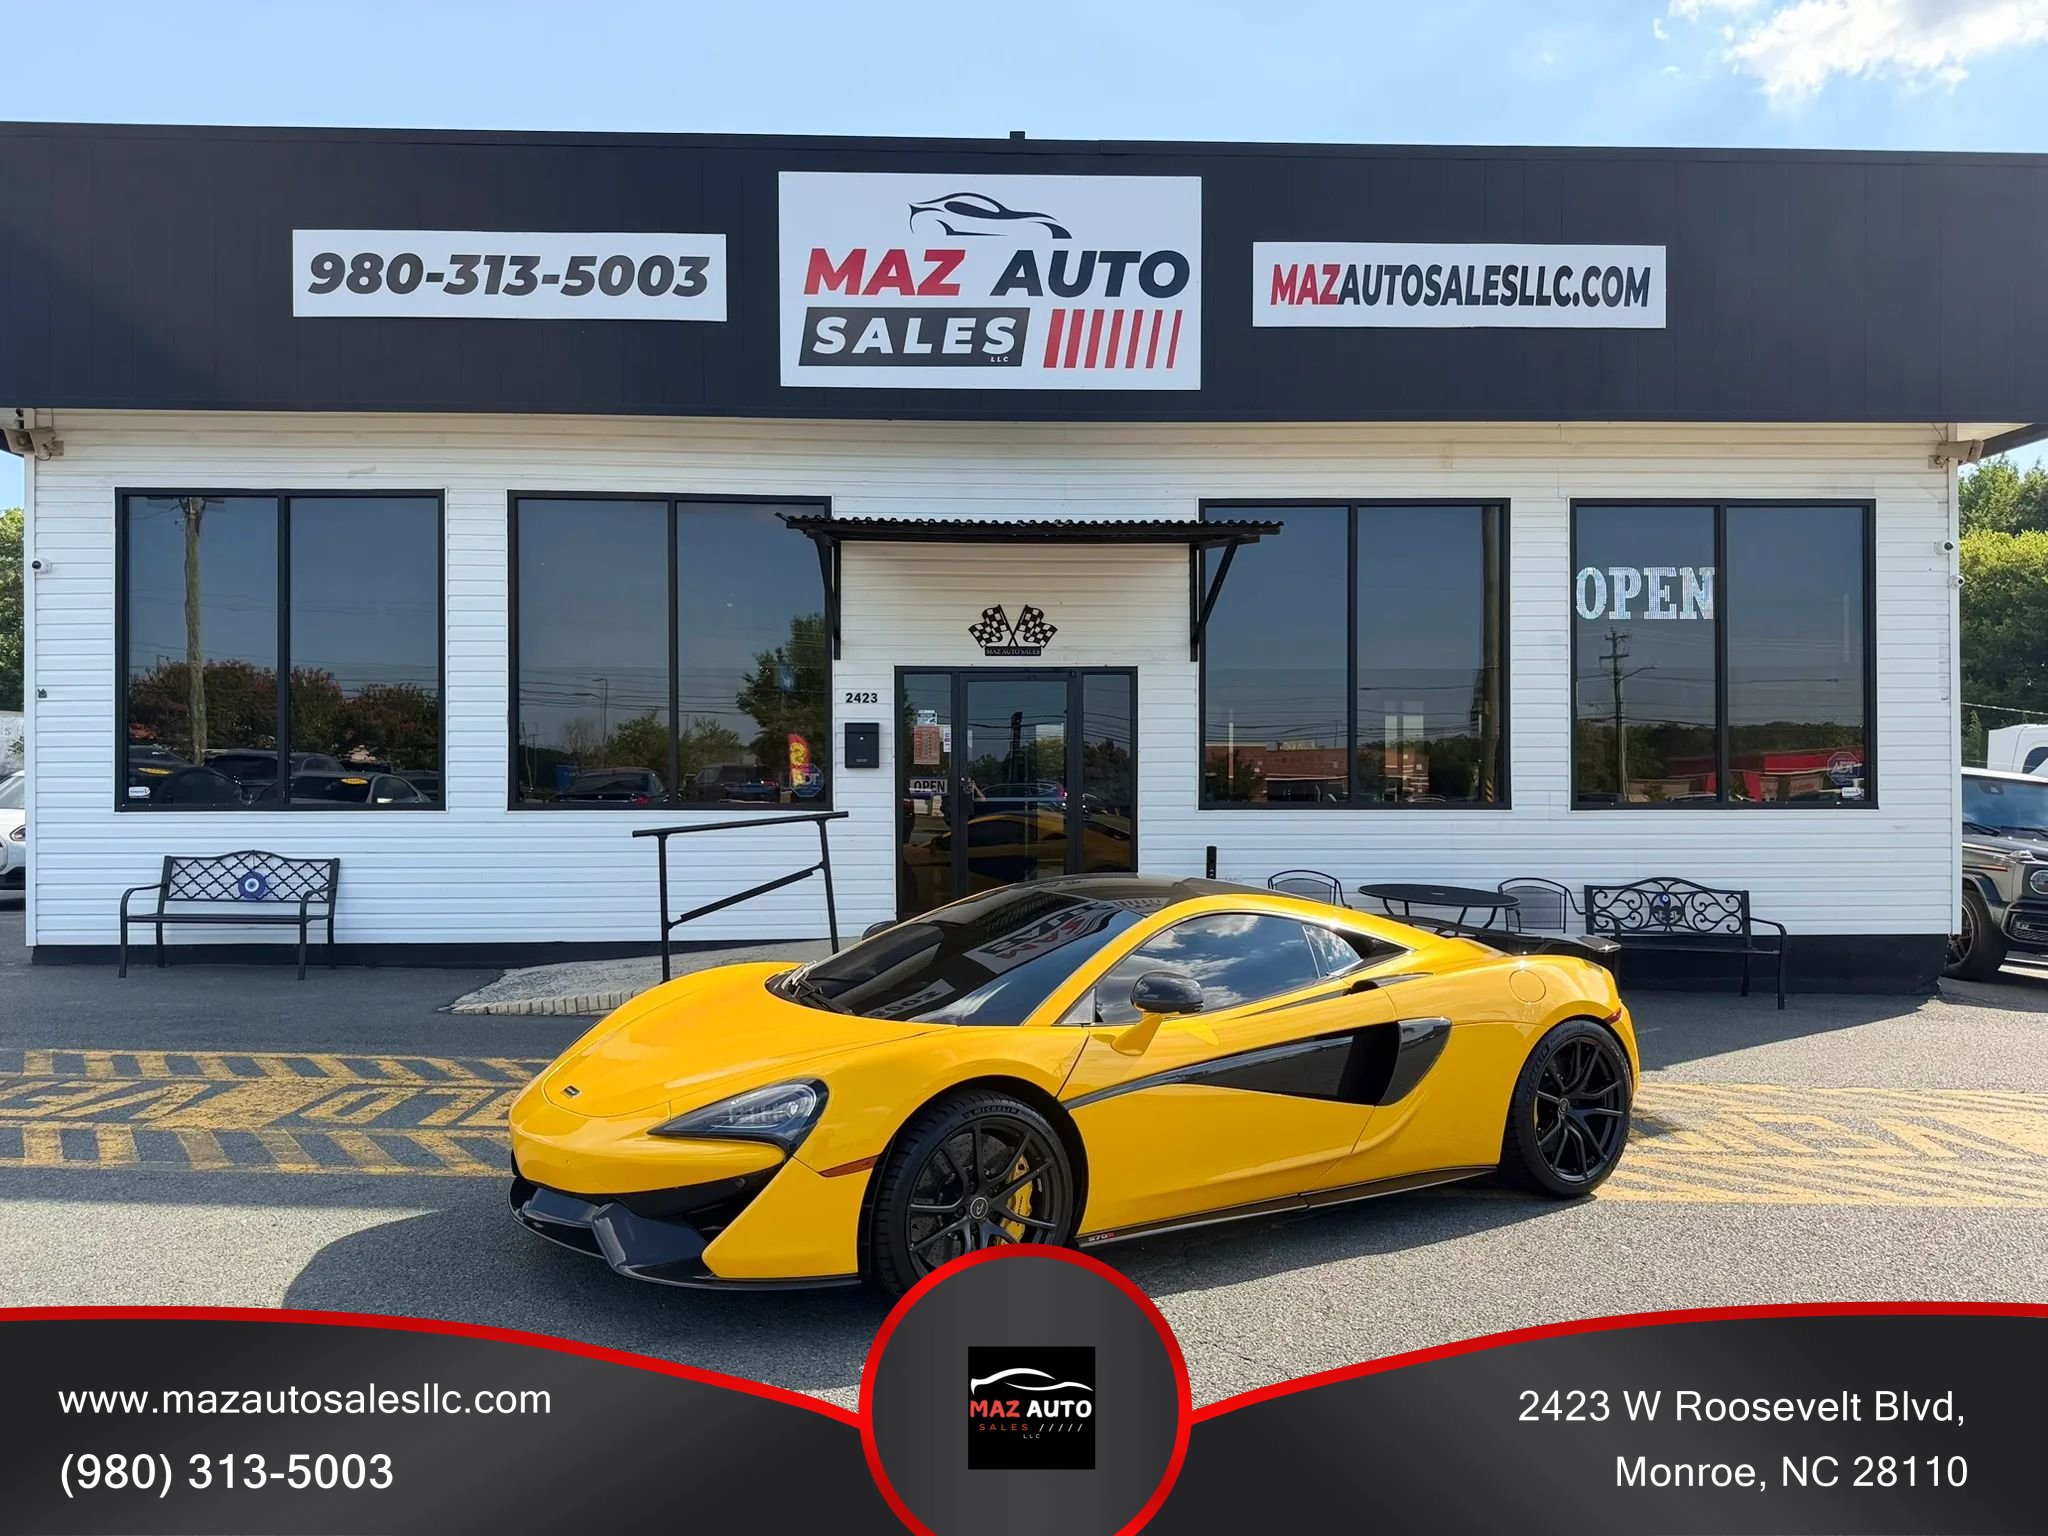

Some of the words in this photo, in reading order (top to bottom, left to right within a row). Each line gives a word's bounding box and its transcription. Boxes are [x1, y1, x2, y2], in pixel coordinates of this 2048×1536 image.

[307, 252, 710, 297] 980-313-5003
[803, 247, 966, 296] MAZ
[989, 249, 1190, 298] AUTO
[1270, 264, 1650, 307] MAZAUTOSALESLLC.COM
[812, 316, 1017, 355] SALES
[1575, 566, 1716, 620] OPEN
[845, 692, 878, 704] 2423
[914, 780, 946, 793] OPEN
